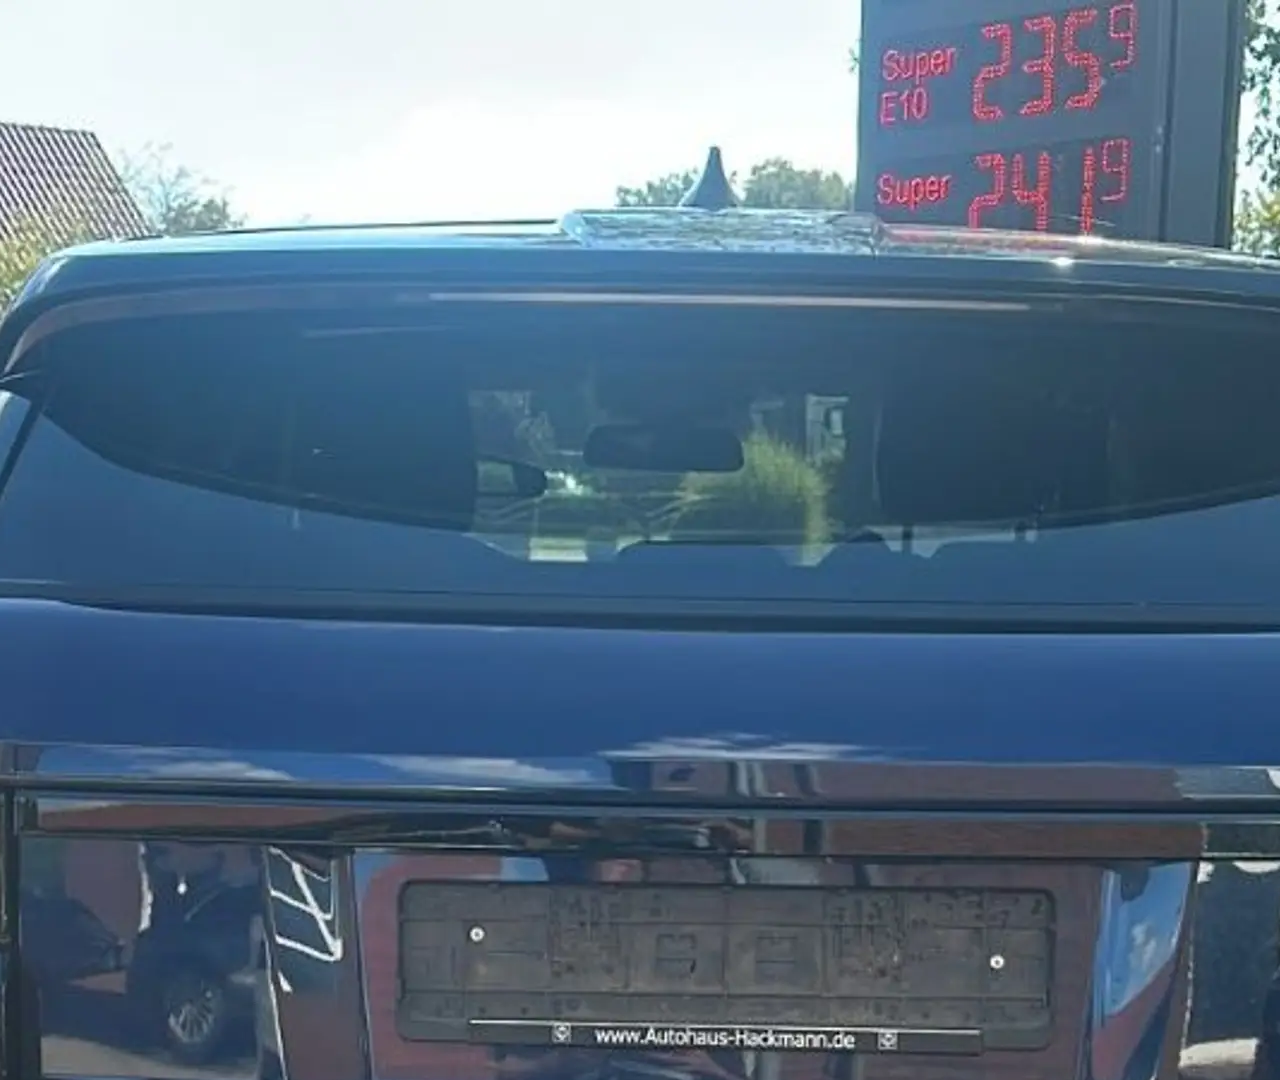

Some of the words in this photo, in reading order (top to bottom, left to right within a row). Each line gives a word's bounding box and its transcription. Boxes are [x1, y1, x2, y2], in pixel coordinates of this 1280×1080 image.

[881, 47, 957, 84] Super
[879, 87, 929, 124] E10
[876, 173, 953, 210] Super
[594, 1026, 856, 1049] www.Autohaus-Hackmann.de
